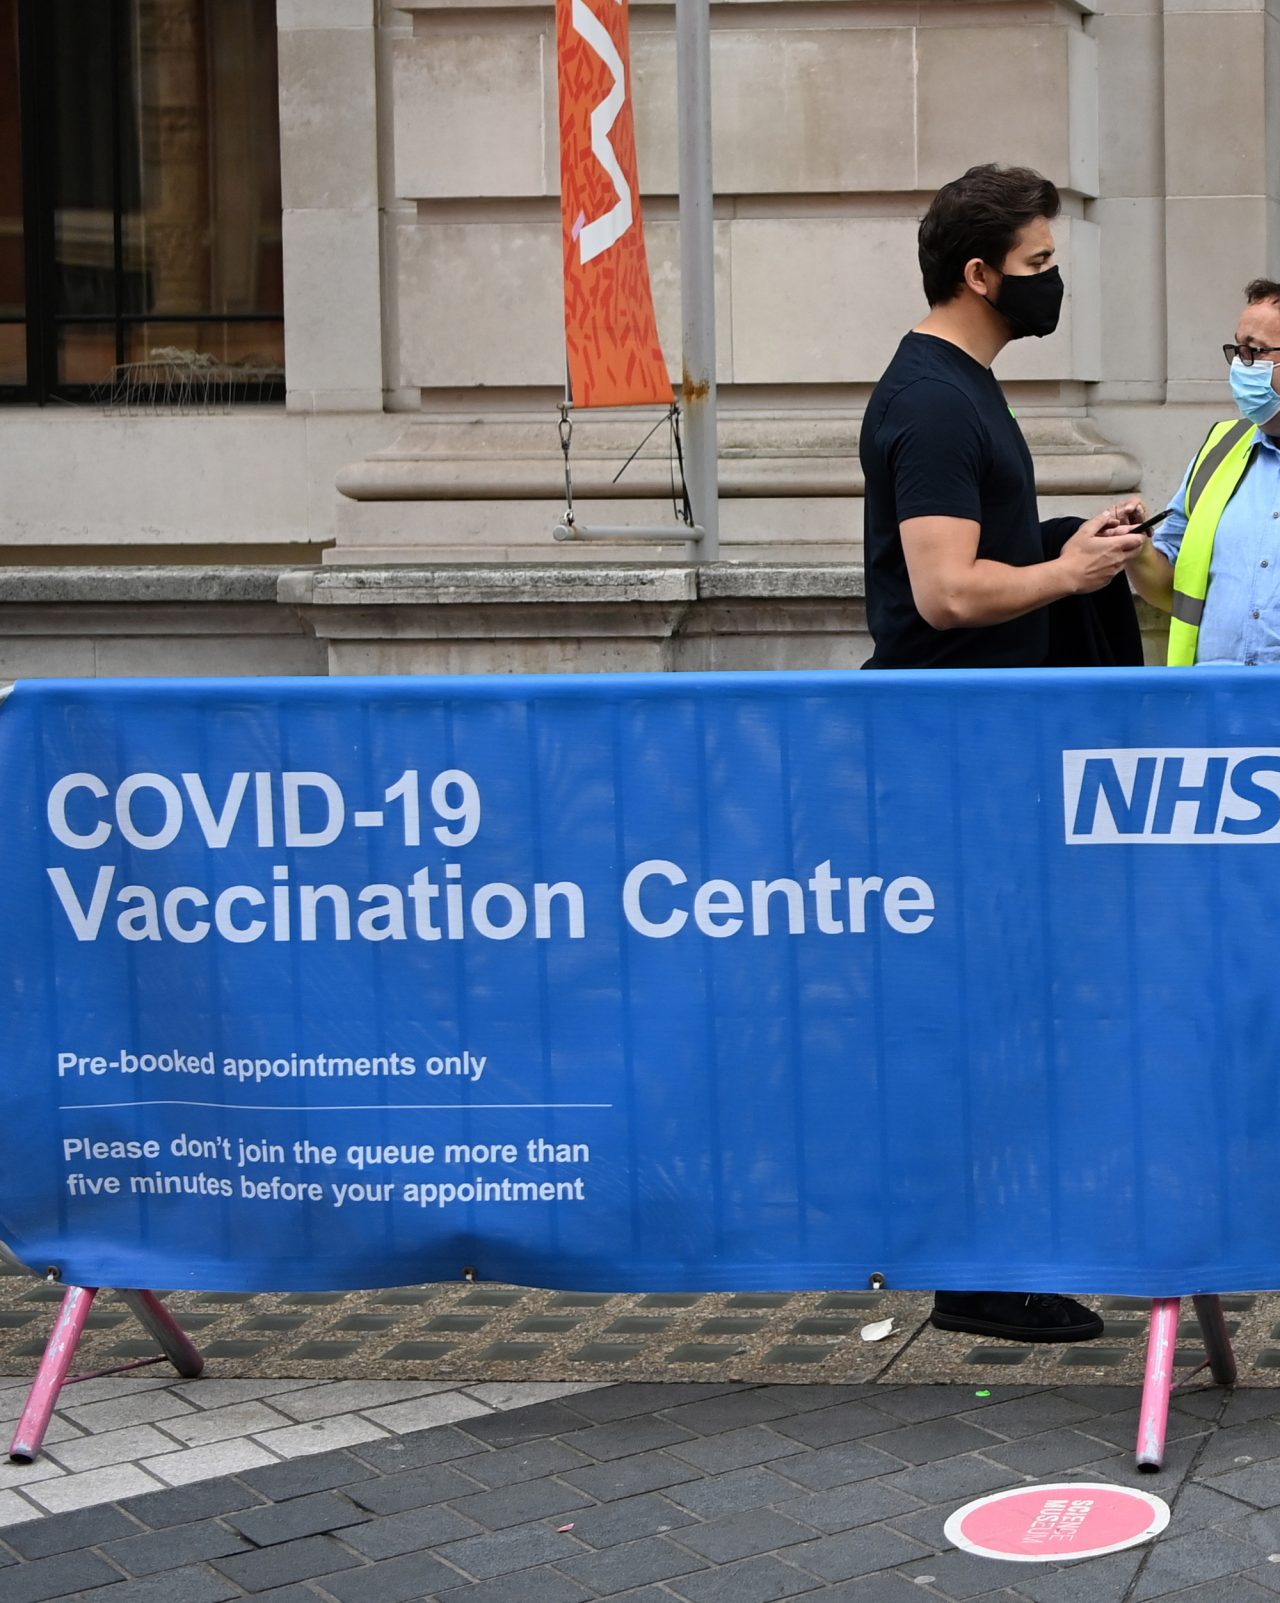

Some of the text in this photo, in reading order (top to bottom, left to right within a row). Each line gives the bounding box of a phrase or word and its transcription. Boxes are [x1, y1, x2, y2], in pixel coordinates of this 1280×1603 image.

[47, 769, 481, 850] COVID-19
[46, 859, 935, 943] Vaccination Centre
[58, 1049, 487, 1083] Pre-booked appointments only
[63, 1134, 589, 1170] Please don’t join the queue more than
[66, 1171, 585, 1208] five minutes before your appointment
[1021, 1499, 1069, 1544] MUSEUM
[1048, 1499, 1094, 1542] SCIENCE
